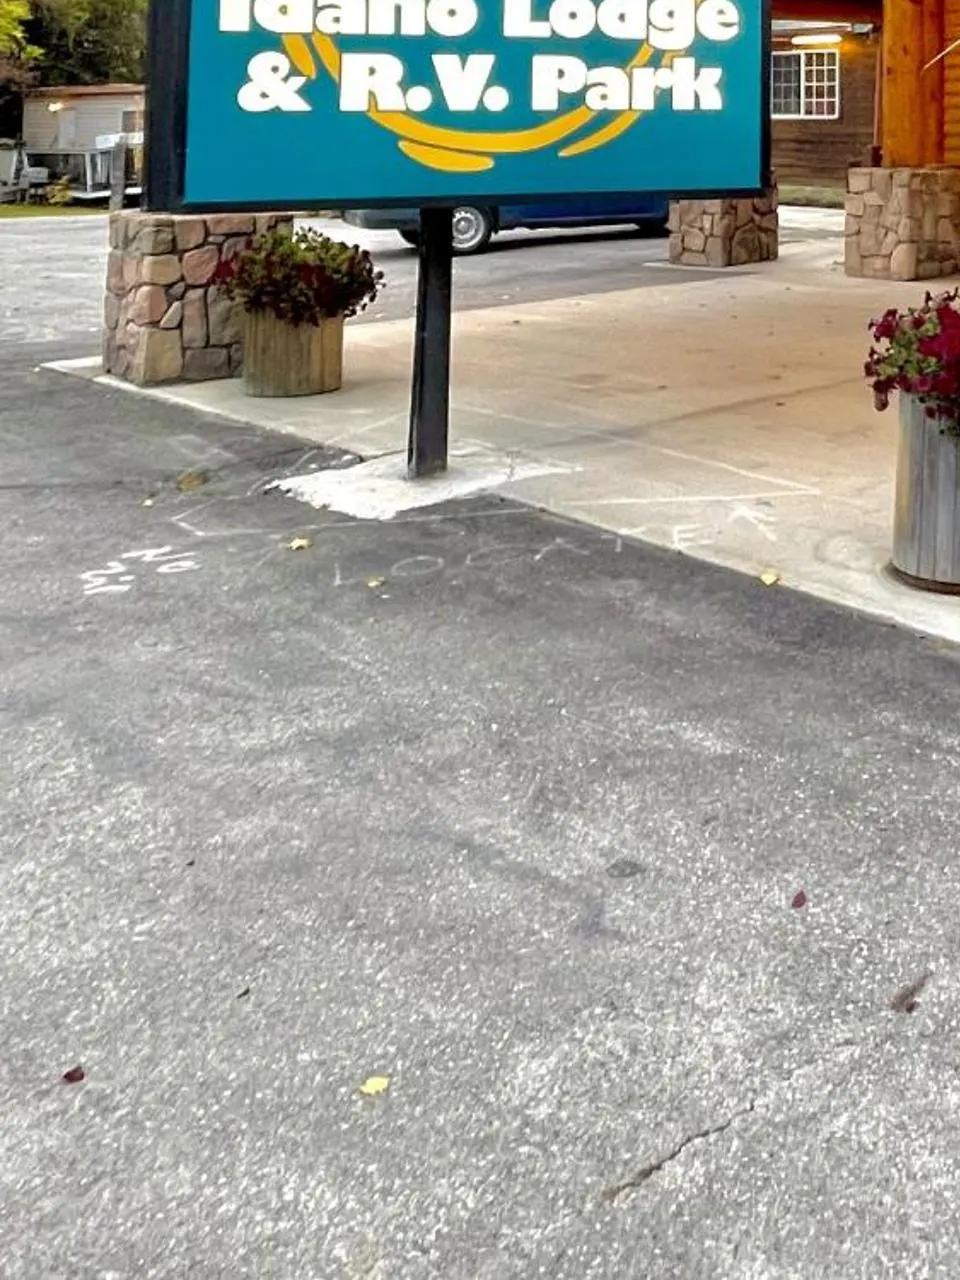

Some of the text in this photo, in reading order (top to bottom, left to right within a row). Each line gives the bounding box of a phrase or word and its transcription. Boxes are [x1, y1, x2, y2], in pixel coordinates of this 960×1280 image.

[237, 51, 722, 112] & R.V. Park
